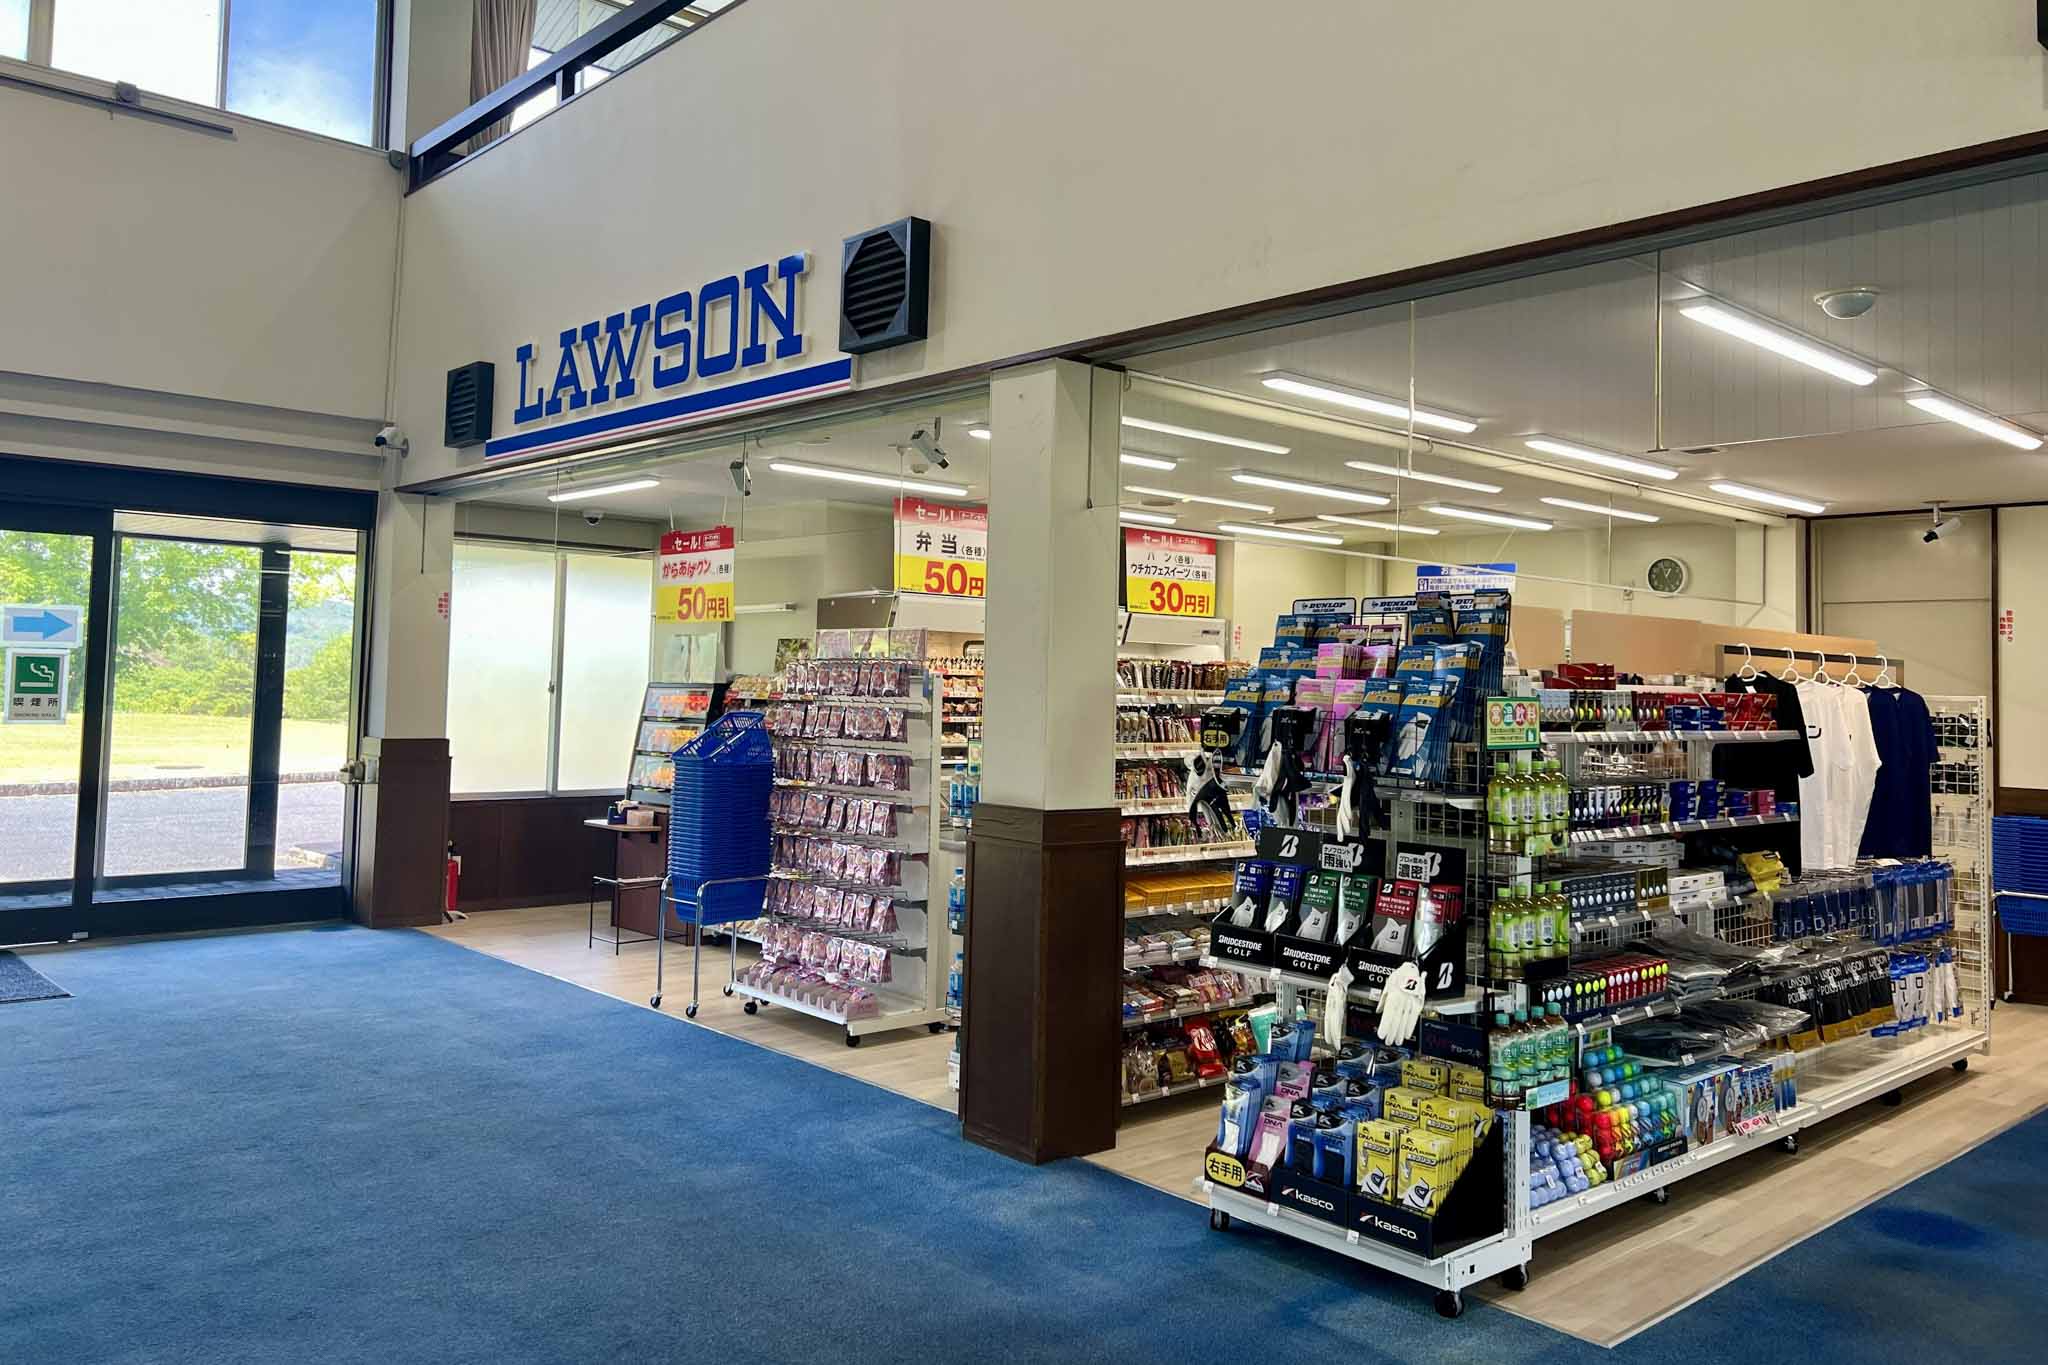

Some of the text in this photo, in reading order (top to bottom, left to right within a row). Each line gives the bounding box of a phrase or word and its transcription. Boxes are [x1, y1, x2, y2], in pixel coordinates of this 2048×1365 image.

[513, 253, 808, 425] LAWSON
[924, 560, 985, 597] 50円
[1130, 563, 1191, 578] ウチカフェスイーツ
[677, 586, 730, 620] 50円引
[1149, 581, 1210, 614] 30円引
[1308, 601, 1347, 609] DUNLOP
[1218, 934, 1262, 951] BRIDGESTONE
[1226, 946, 1252, 958] GOLF
[1283, 947, 1332, 965] BRIDGESTONE
[1292, 959, 1320, 971] GOLF
[1368, 973, 1384, 983] GO
[1208, 1157, 1242, 1182] 右手用
[1295, 1188, 1335, 1211] kasco
[1374, 1215, 1417, 1240] kasco
